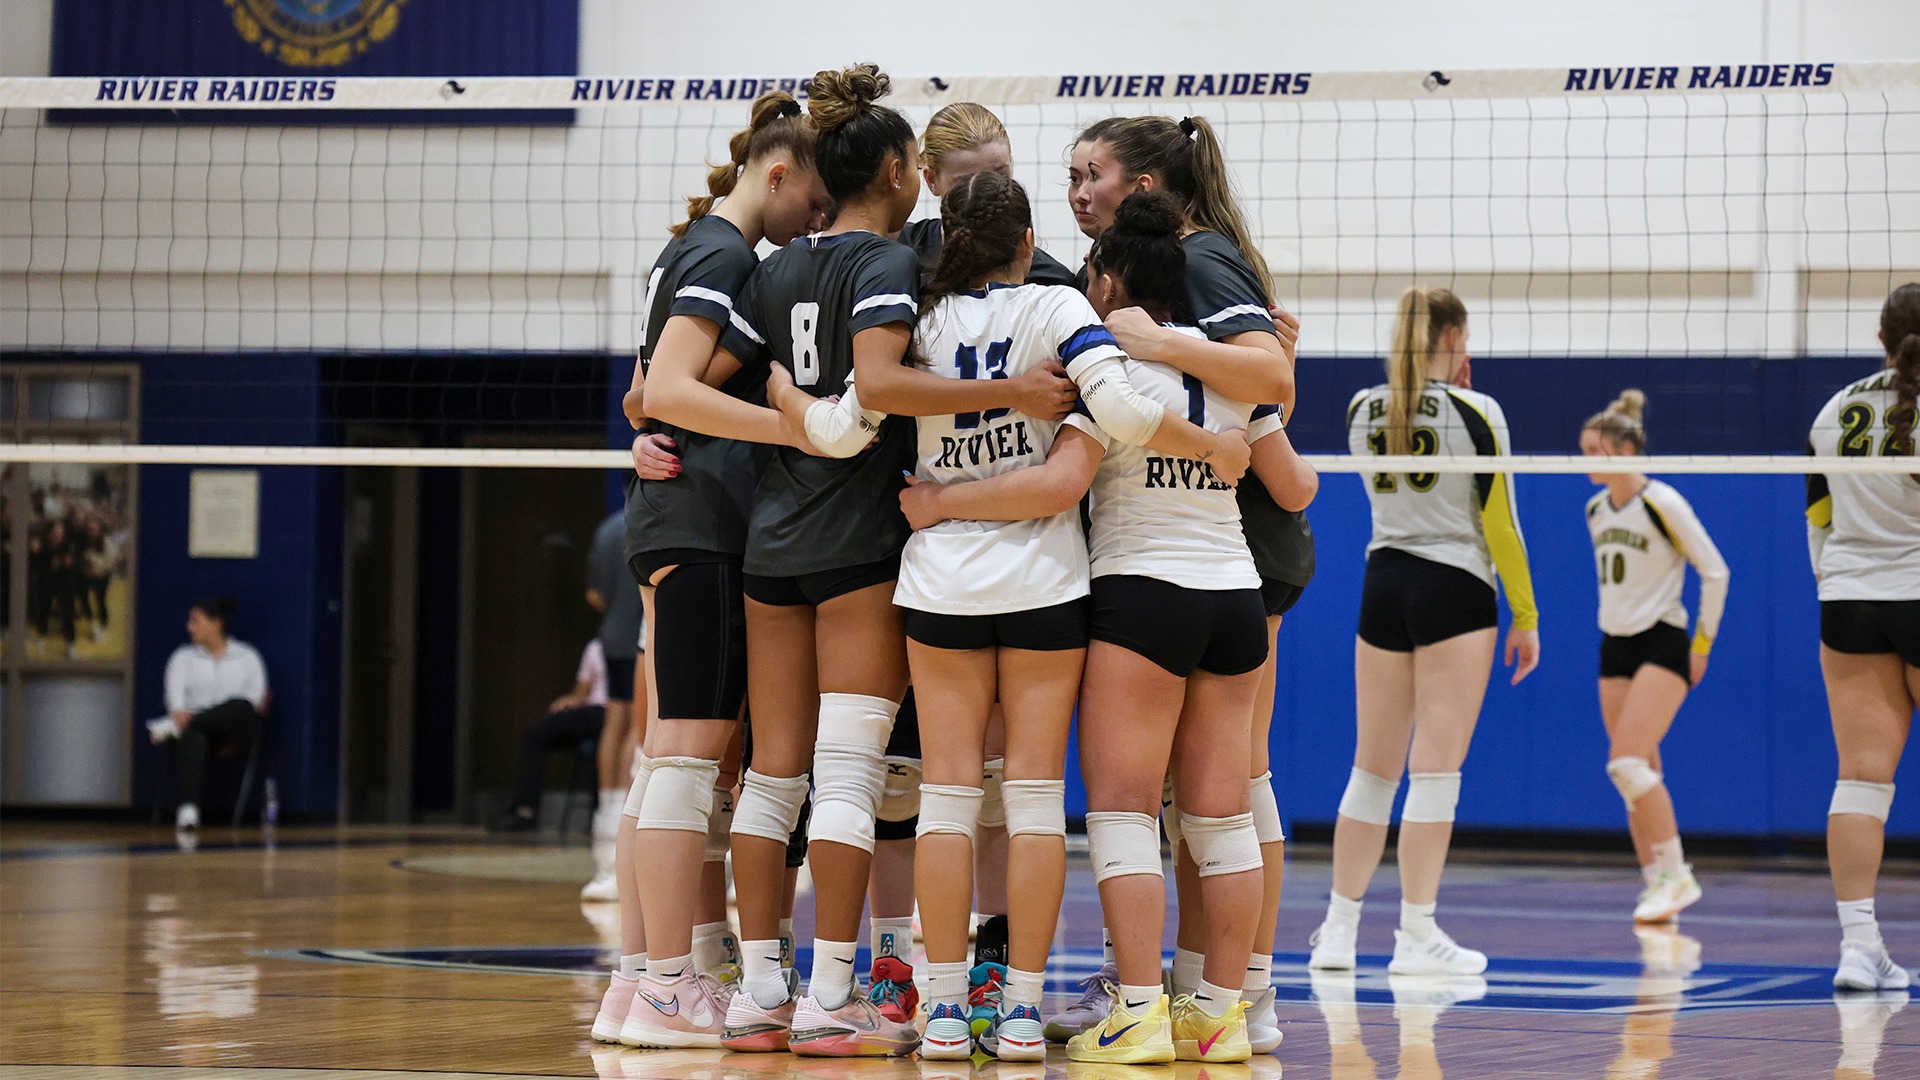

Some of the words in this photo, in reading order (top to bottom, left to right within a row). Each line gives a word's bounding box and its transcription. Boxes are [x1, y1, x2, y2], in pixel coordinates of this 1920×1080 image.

[572, 79, 675, 101] RIVIER
[1056, 75, 1165, 98] RIVIER
[1173, 73, 1312, 97] RAIDERS
[1564, 67, 1679, 91] RIVIER
[1688, 63, 1834, 89] RAIDERS
[96, 80, 199, 101] RIVIER
[207, 80, 336, 101] RAIDERS
[791, 302, 820, 386] 8
[934, 421, 1034, 469] RIVIER
